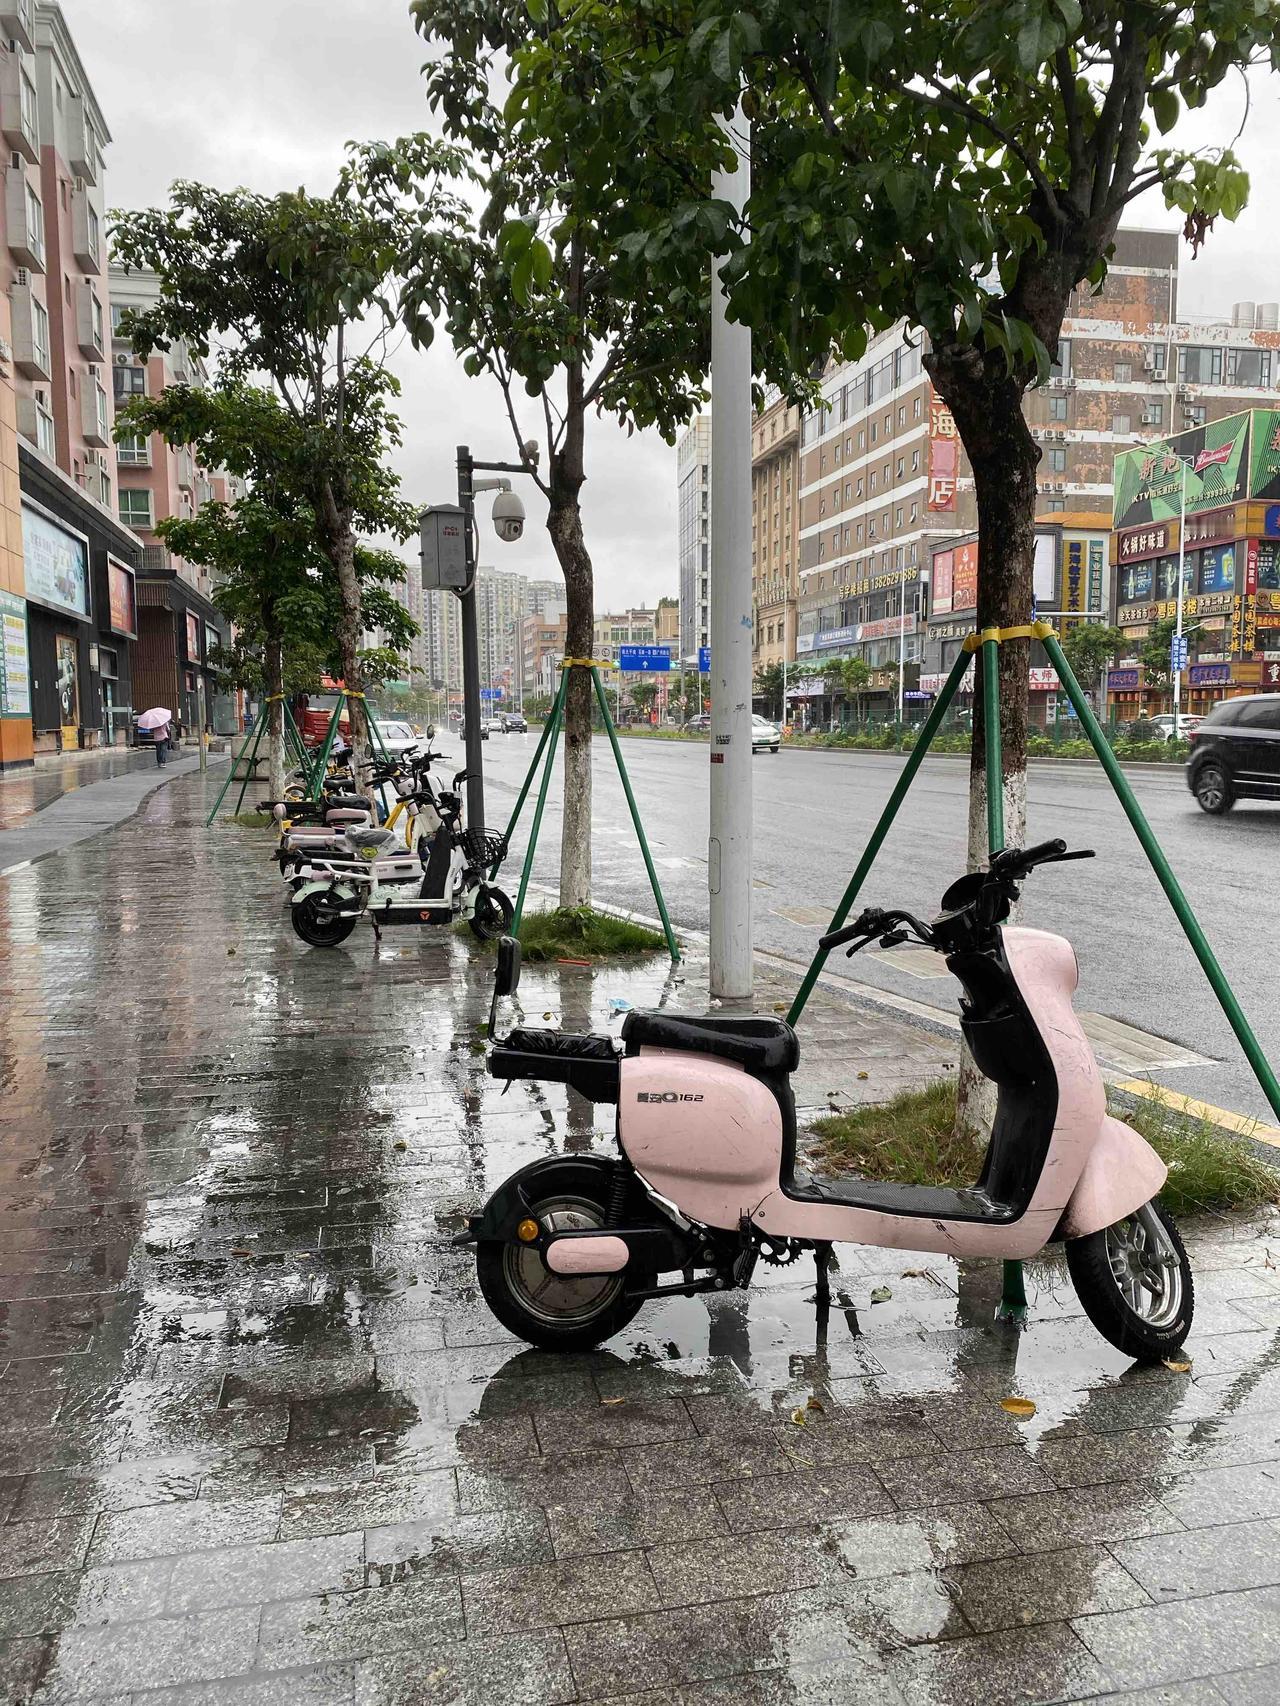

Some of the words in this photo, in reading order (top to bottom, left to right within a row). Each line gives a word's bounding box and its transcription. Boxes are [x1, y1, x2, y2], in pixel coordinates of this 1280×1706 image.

[1122, 529, 1165, 556] 火锅好味道
